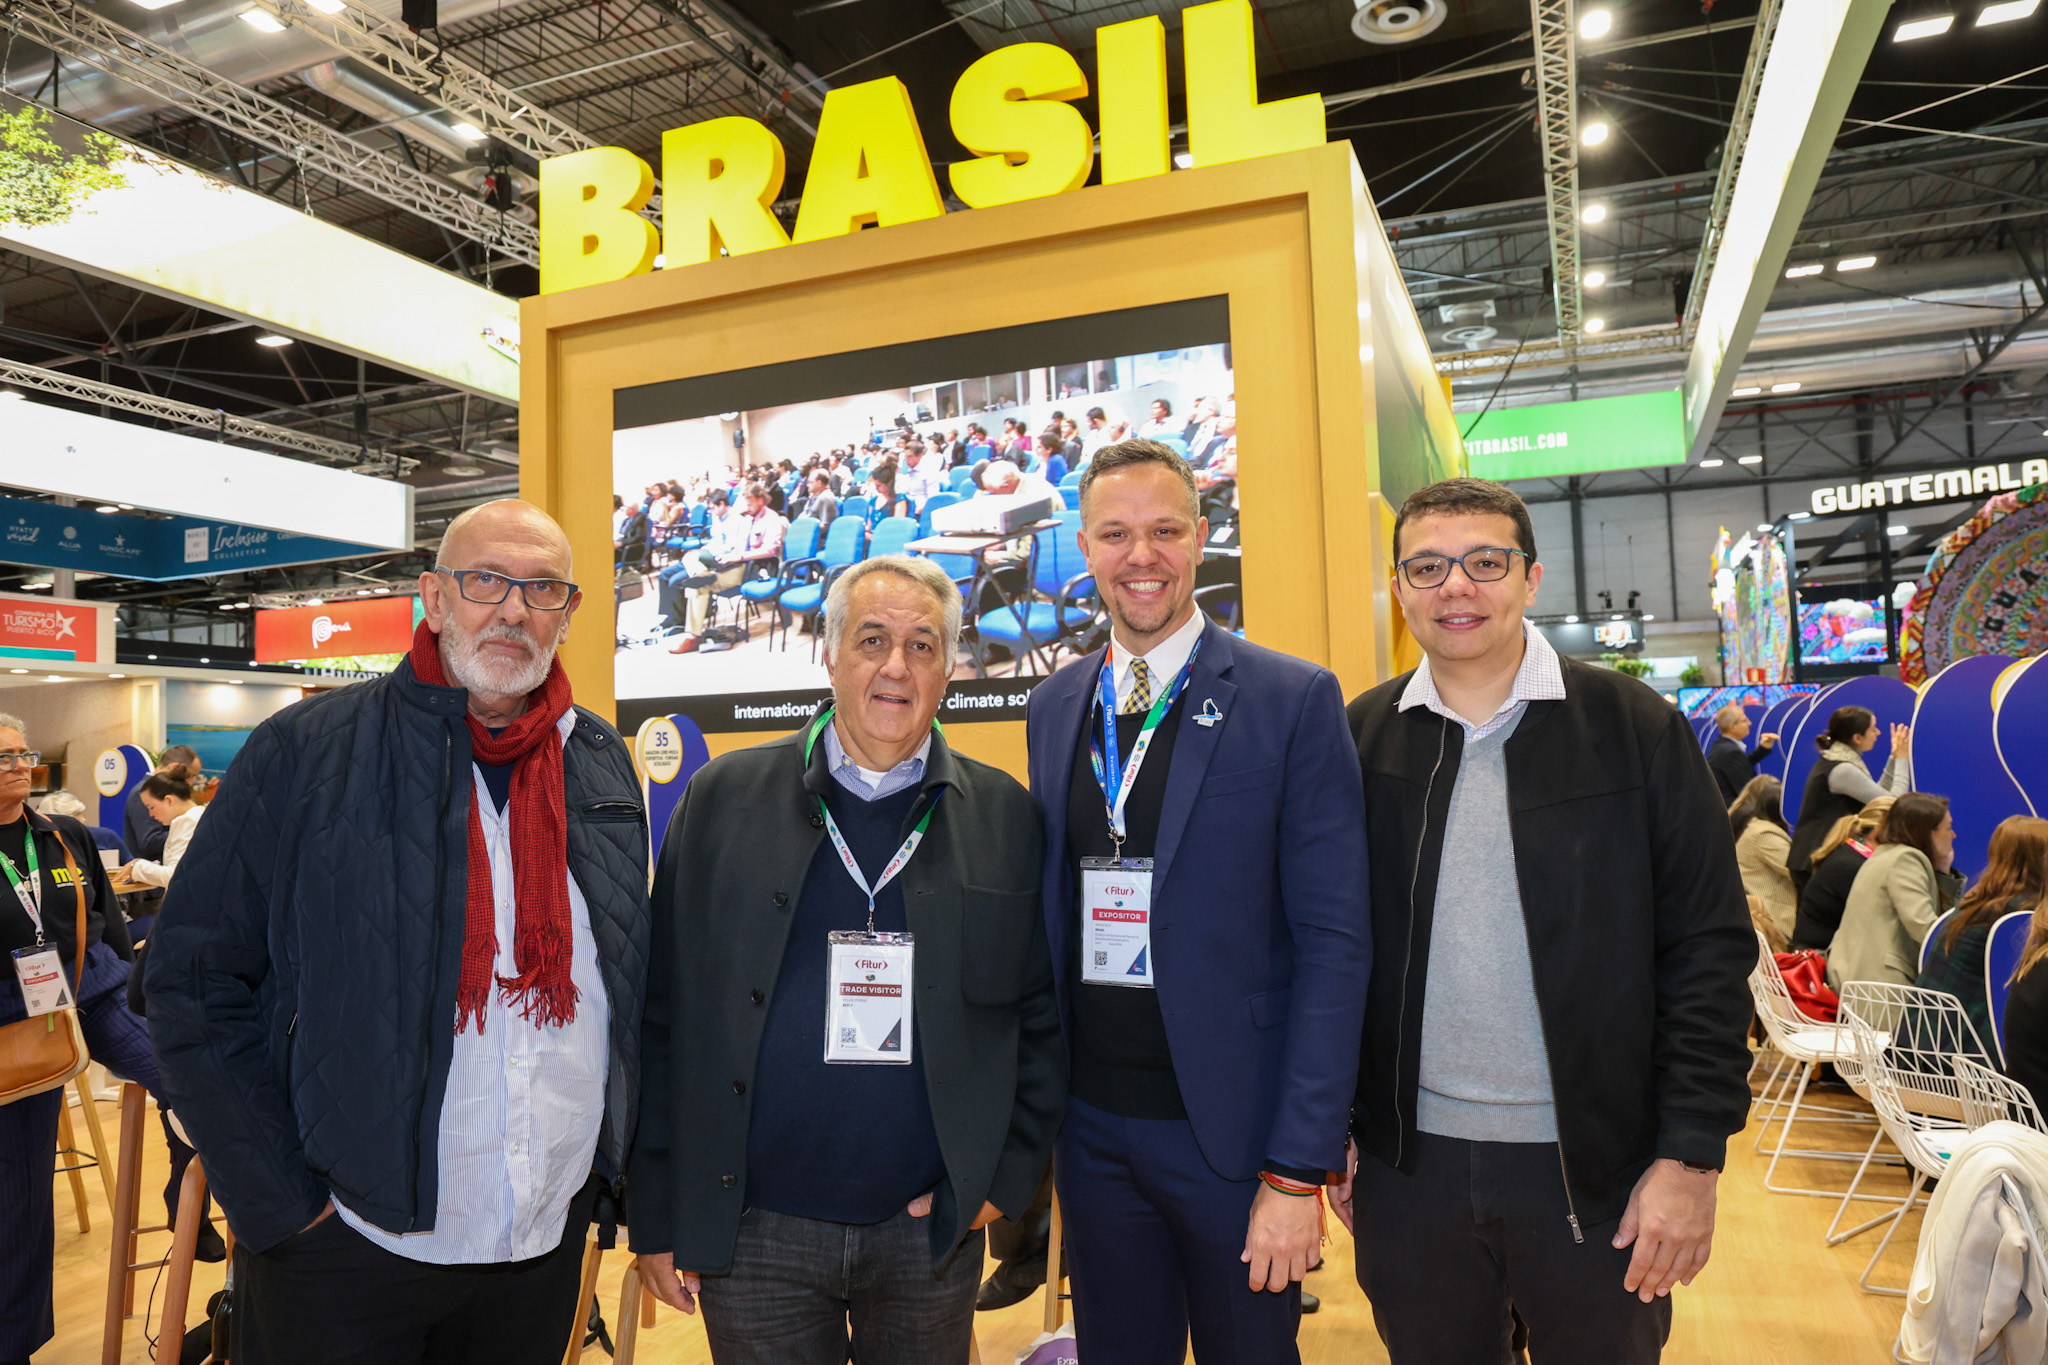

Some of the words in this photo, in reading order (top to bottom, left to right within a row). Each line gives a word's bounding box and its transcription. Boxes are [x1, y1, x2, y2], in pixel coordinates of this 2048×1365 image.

[540, 0, 1326, 295] BRASIL
[1811, 458, 2048, 515] GUATEMALA
[212, 525, 268, 552] Inclusive
[214, 548, 267, 560] COLLECTION
[3, 614, 56, 629] TURISMO
[6, 626, 35, 635] PUERTO
[946, 692, 1004, 709] climate
[655, 731, 669, 747] 35
[104, 758, 116, 770] 05
[1110, 886, 1130, 896] Fitur
[1098, 911, 1142, 920] EXPOSITOR
[861, 960, 883, 970] Fitur
[25, 974, 55, 985] EXPOSITOR
[840, 985, 867, 993] TRADE
[869, 986, 902, 995] VISITOR
